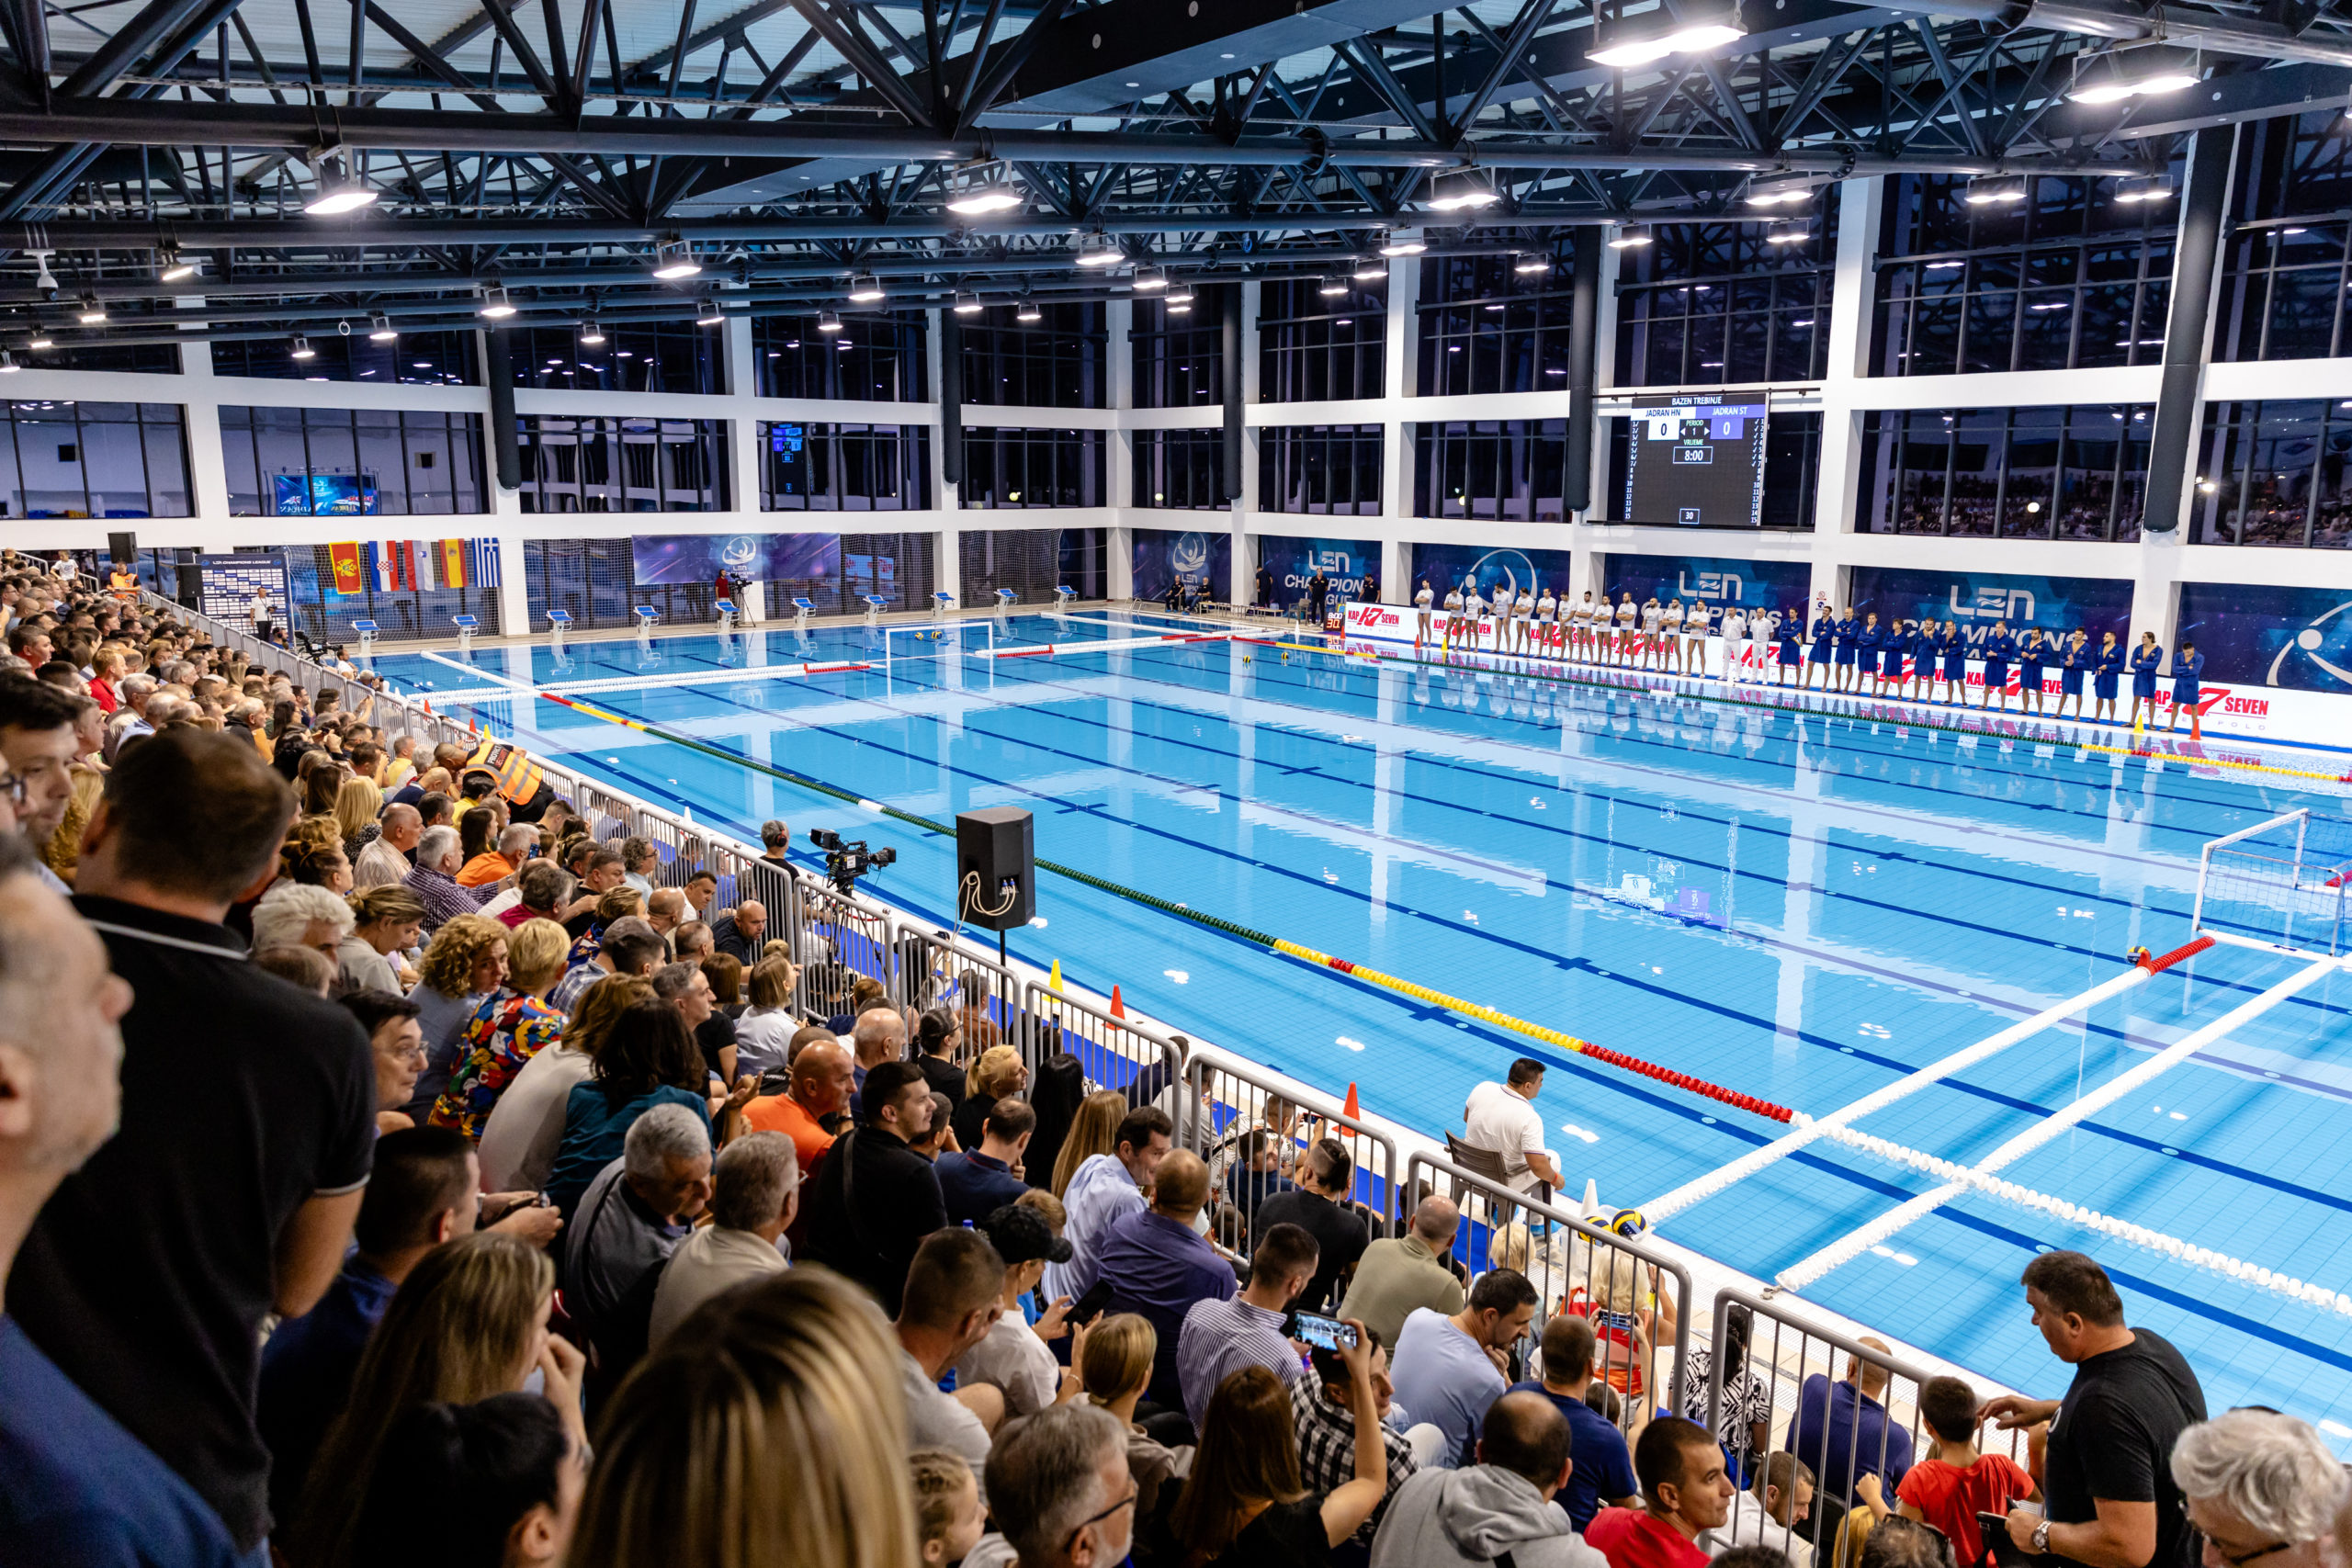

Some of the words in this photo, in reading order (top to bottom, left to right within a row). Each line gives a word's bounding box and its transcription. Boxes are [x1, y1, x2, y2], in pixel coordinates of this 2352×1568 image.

[1672, 397, 1692, 406] BAZEN
[1693, 396, 1722, 405] TREBINJE
[1645, 409, 1670, 417] JADRAN
[1712, 407, 1738, 416] JADRAN
[1739, 407, 1747, 415] ST
[1660, 423, 1668, 436] 0
[1692, 427, 1696, 436] 1
[1723, 421, 1731, 436] 0
[1684, 449, 1704, 461] 8:00
[1685, 511, 1694, 520] 30
[1308, 550, 1351, 573] LEN
[1284, 573, 1364, 593] CHAPION
[1679, 570, 1743, 601] LEN
[1950, 584, 2036, 621] LEN
[1348, 610, 1360, 620] KAP
[1381, 613, 1400, 626] SEVEN
[1433, 618, 1446, 629] KAP
[2224, 696, 2269, 716] SEVEN
[2217, 720, 2267, 731] POLO
